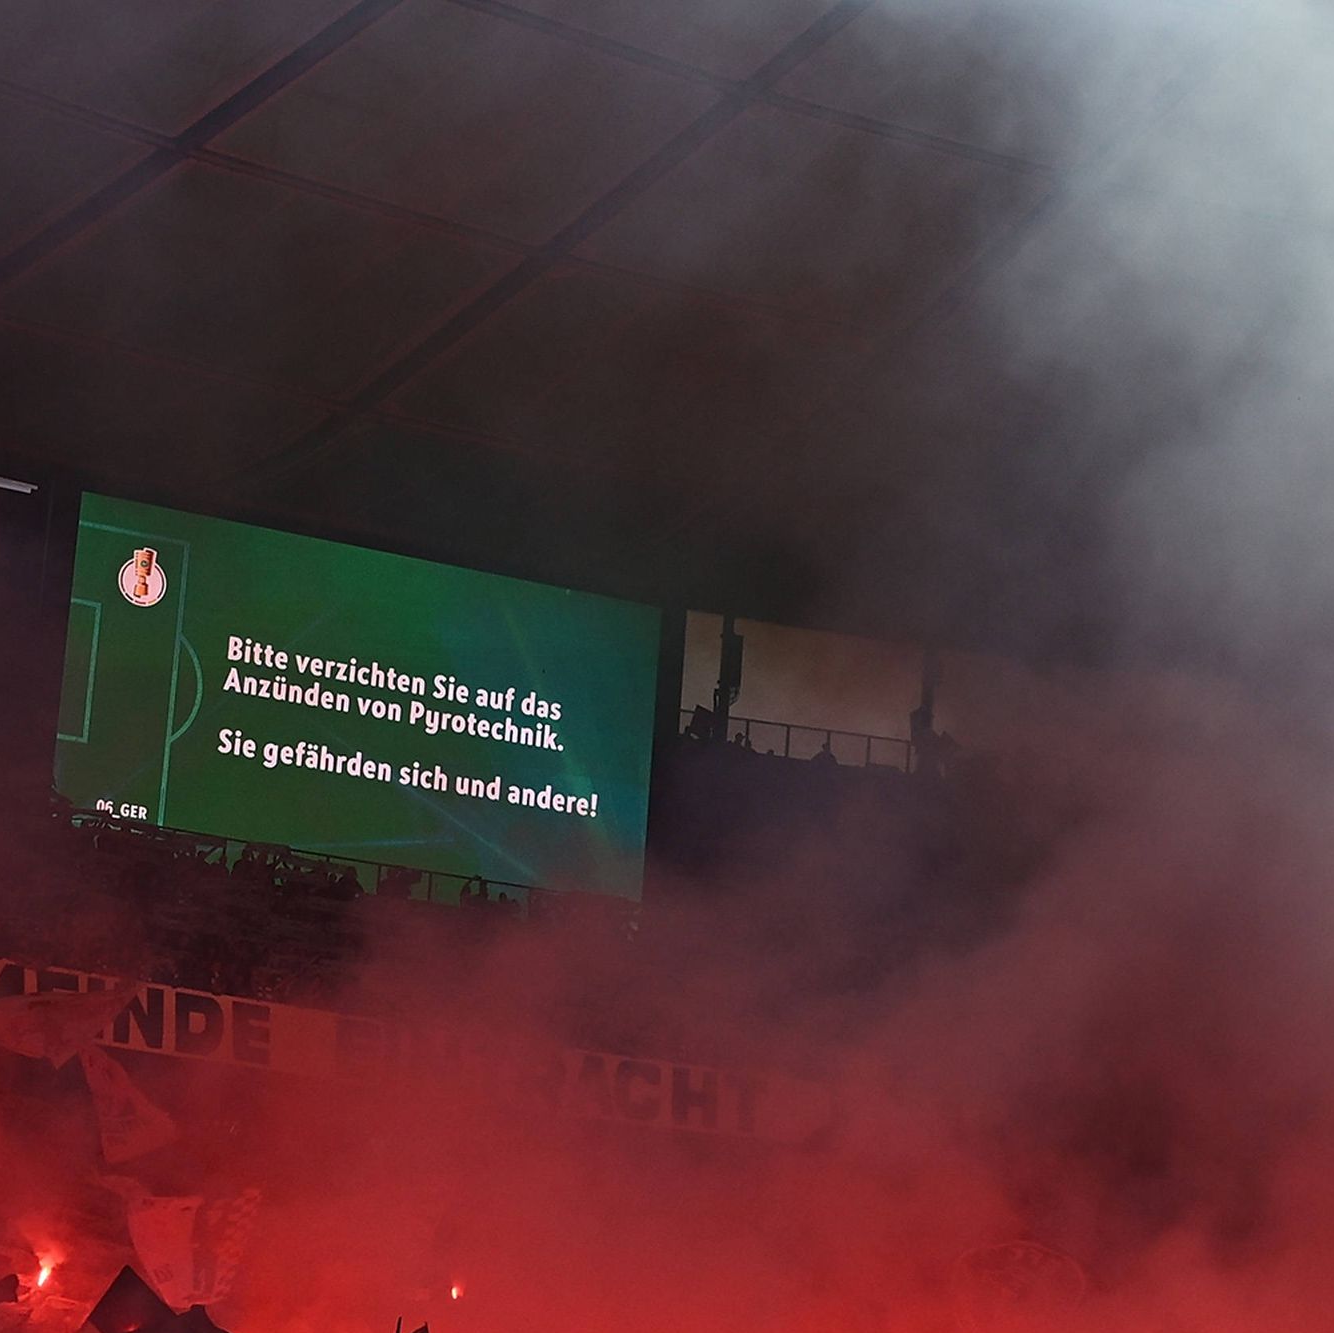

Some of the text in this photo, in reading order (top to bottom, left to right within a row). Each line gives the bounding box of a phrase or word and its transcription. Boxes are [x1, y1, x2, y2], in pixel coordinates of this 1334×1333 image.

[223, 667, 564, 752] Anzünden von Pyrotechnik.
[227, 635, 562, 721] Bitte verzichten Sie auf das
[217, 728, 599, 818] Sie gefährden sich und andere!
